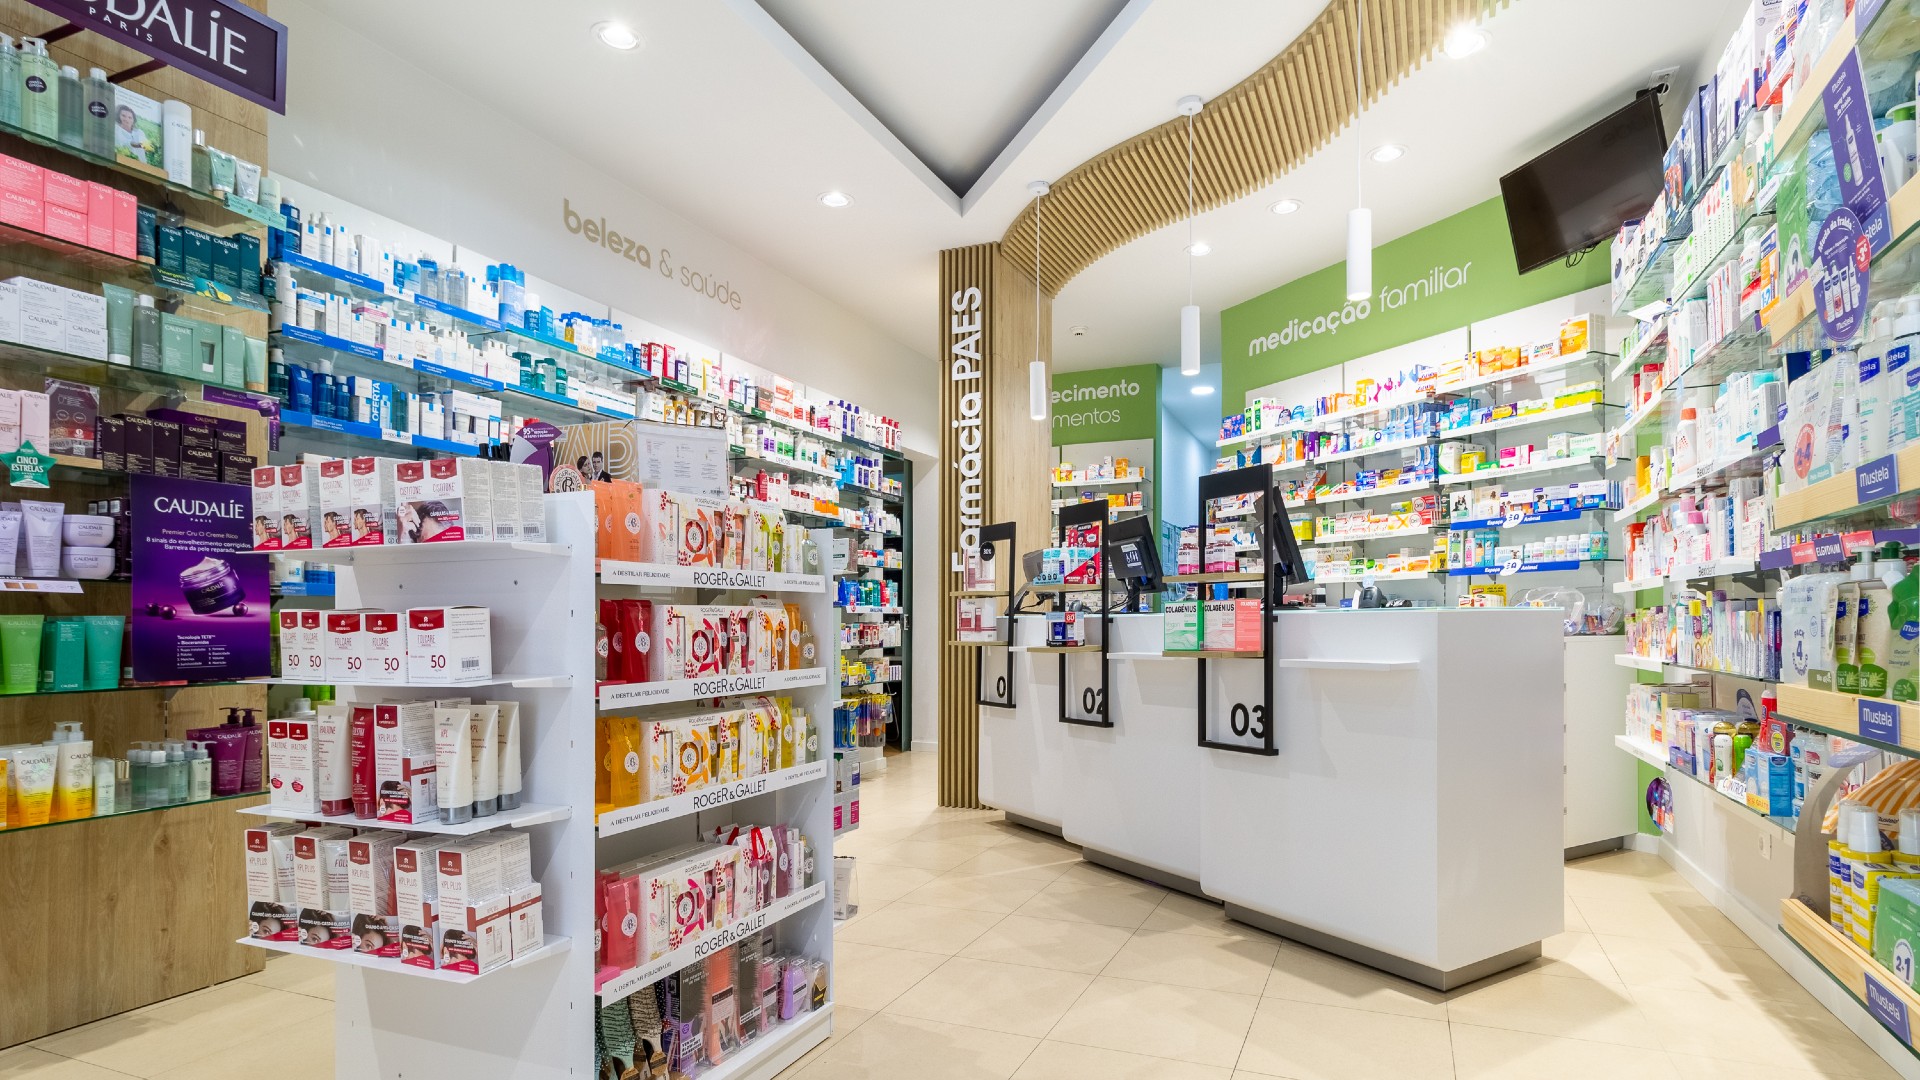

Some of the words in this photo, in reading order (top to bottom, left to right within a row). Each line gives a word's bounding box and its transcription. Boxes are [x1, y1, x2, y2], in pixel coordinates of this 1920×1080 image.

[89, 6, 153, 43] PARIS
[84, 0, 247, 74] ALÍE
[1830, 220, 1837, 230] da
[563, 197, 651, 270] beleza
[660, 249, 673, 279] &
[680, 266, 742, 310] saúde
[1249, 300, 1371, 356] medicação
[1379, 261, 1472, 312] familiar
[952, 286, 982, 381] PAES
[372, 383, 380, 421] OFERTA
[1053, 408, 1120, 428] mentos
[11, 463, 44, 473] ESTRELAS
[16, 455, 38, 465] CINCO
[1859, 466, 1889, 488] Mustela
[178, 539, 223, 547] envelhecimento
[643, 571, 671, 579] FELICIDADE
[1165, 603, 1197, 613] COLAGÉNIUS
[1204, 602, 1235, 612] COLAGÉNIUS
[288, 655, 300, 666] 50
[310, 656, 321, 667] 50
[348, 657, 362, 670] 50
[384, 657, 400, 671] 50
[430, 655, 446, 668] 50
[616, 690, 641, 698] DESTILAR
[642, 689, 670, 697] FELICIDADE
[1083, 687, 1102, 715] 02
[1231, 703, 1265, 739] 03
[1863, 708, 1893, 727] Mustela
[616, 814, 641, 825] DESTILAR
[642, 806, 670, 819] FELICIDADE
[619, 974, 644, 991] DESTILAR
[645, 962, 672, 981] FELICIDADE
[1870, 984, 1900, 1020] Mustela
